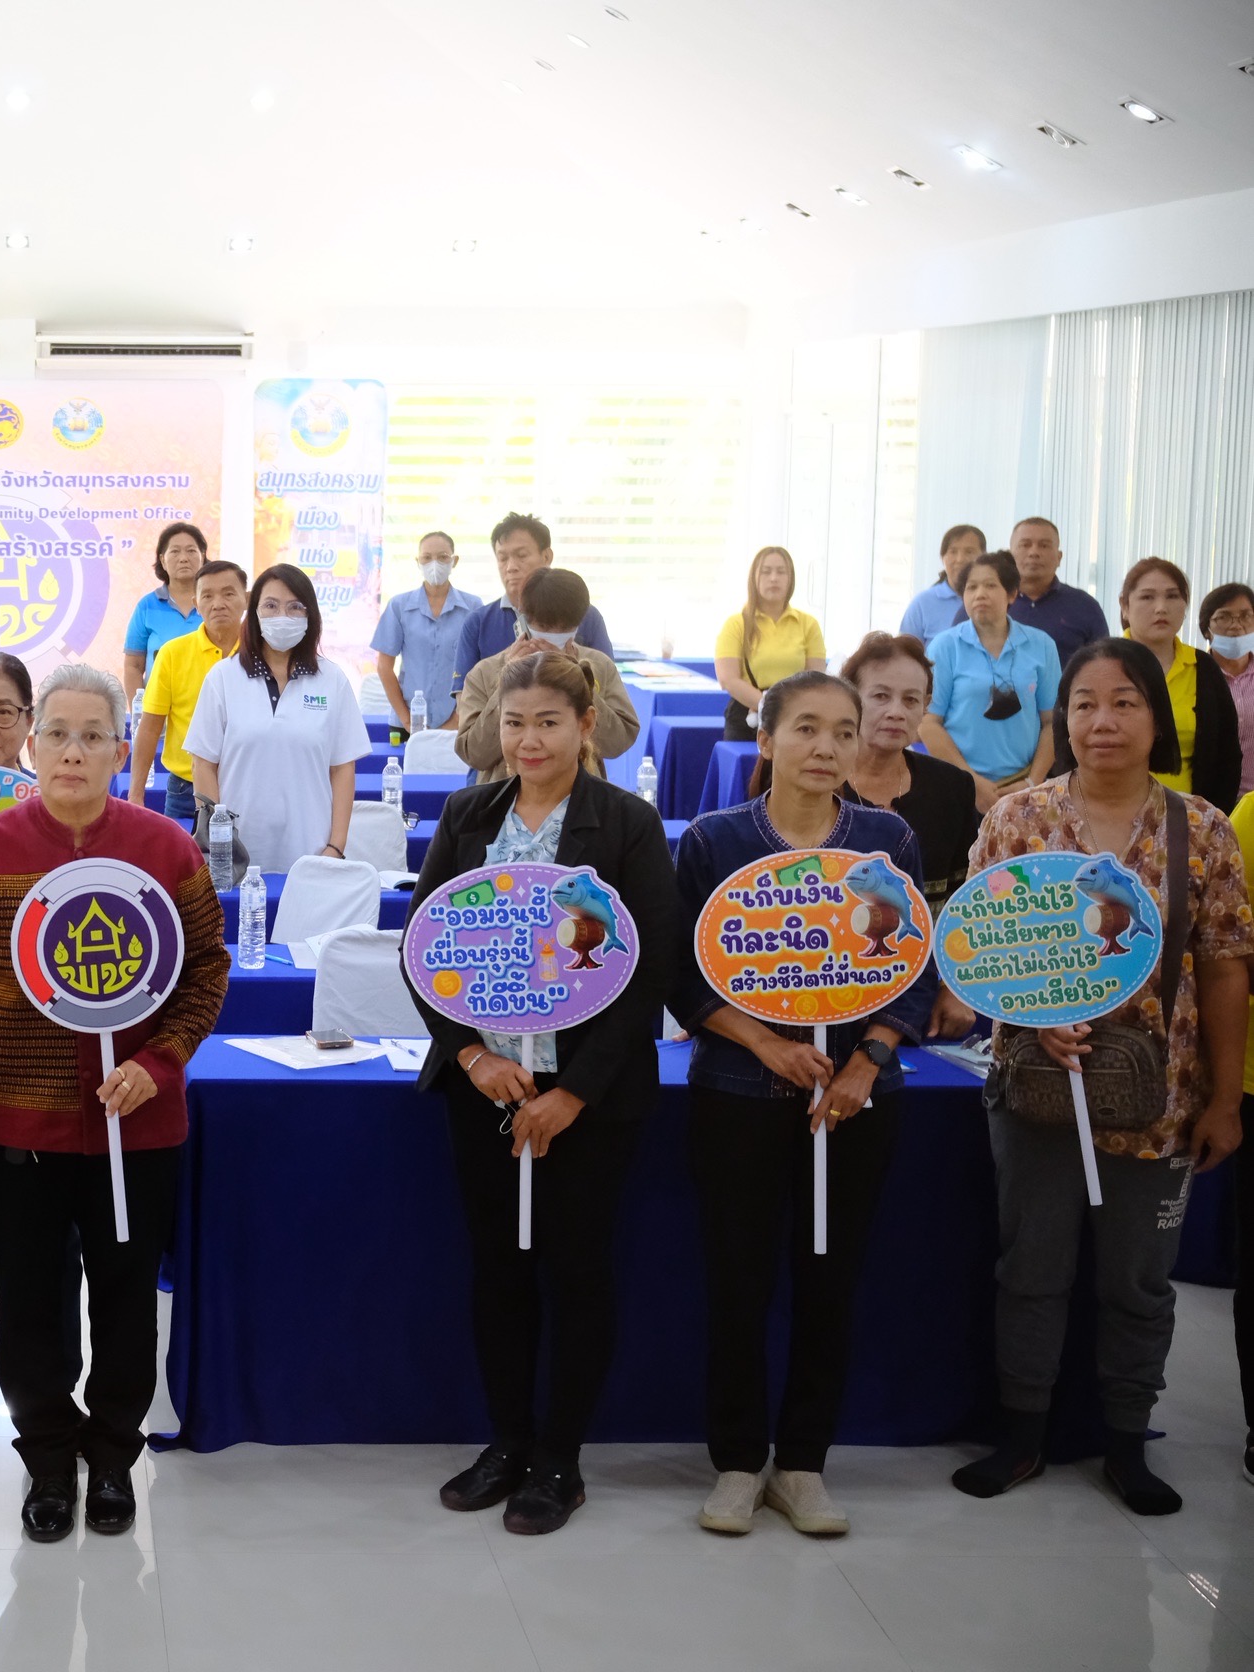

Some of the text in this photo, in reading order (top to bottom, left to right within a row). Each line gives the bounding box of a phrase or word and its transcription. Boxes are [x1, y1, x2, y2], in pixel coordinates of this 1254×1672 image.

[259, 472, 380, 493] สมุทรสงคราม
[39, 507, 138, 522] Development
[144, 507, 192, 520] Office
[297, 507, 339, 525] เมือง
[299, 544, 334, 564] แห่ง
[303, 694, 327, 704] SME
[430, 886, 548, 926] "ออมวันนี้
[727, 873, 844, 908] "เก็บเงิน
[949, 883, 1075, 919] "เก็บเงินไว้
[425, 928, 530, 973] เพื่อพรุ่งนี้
[720, 915, 829, 954] ทีละนิด
[962, 918, 1078, 949] ไม่เสียหาย
[730, 954, 906, 993] สร้างชีวิตที่มั่นคง"
[956, 945, 1098, 982] แต่ถ้าไม่เก็บไว้
[467, 972, 566, 1012] ที่ดีขึ้น"
[1000, 977, 1118, 1010] อาจเสียใจ"
